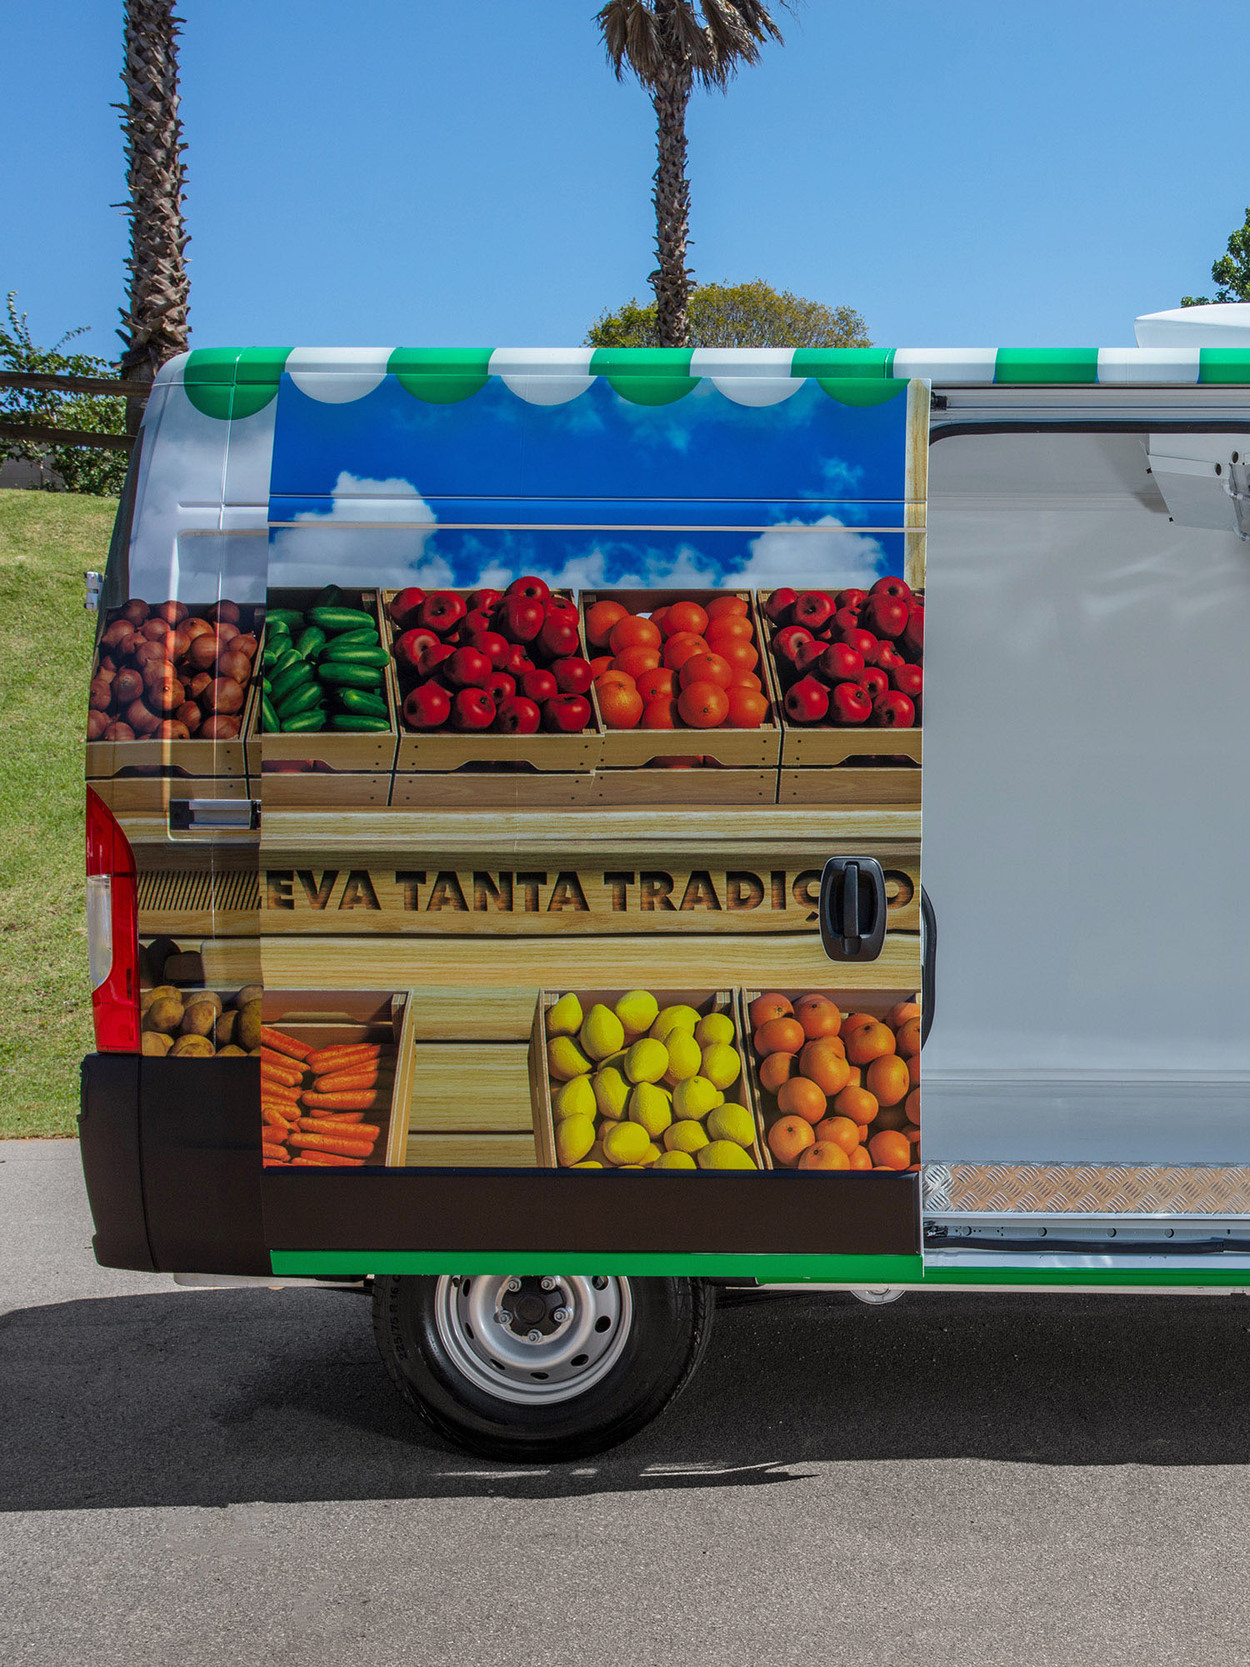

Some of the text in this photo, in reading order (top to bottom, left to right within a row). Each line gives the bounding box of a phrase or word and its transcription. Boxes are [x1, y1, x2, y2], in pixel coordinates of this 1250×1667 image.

[258, 869, 915, 922] EVA TANTA TRADIÇO
